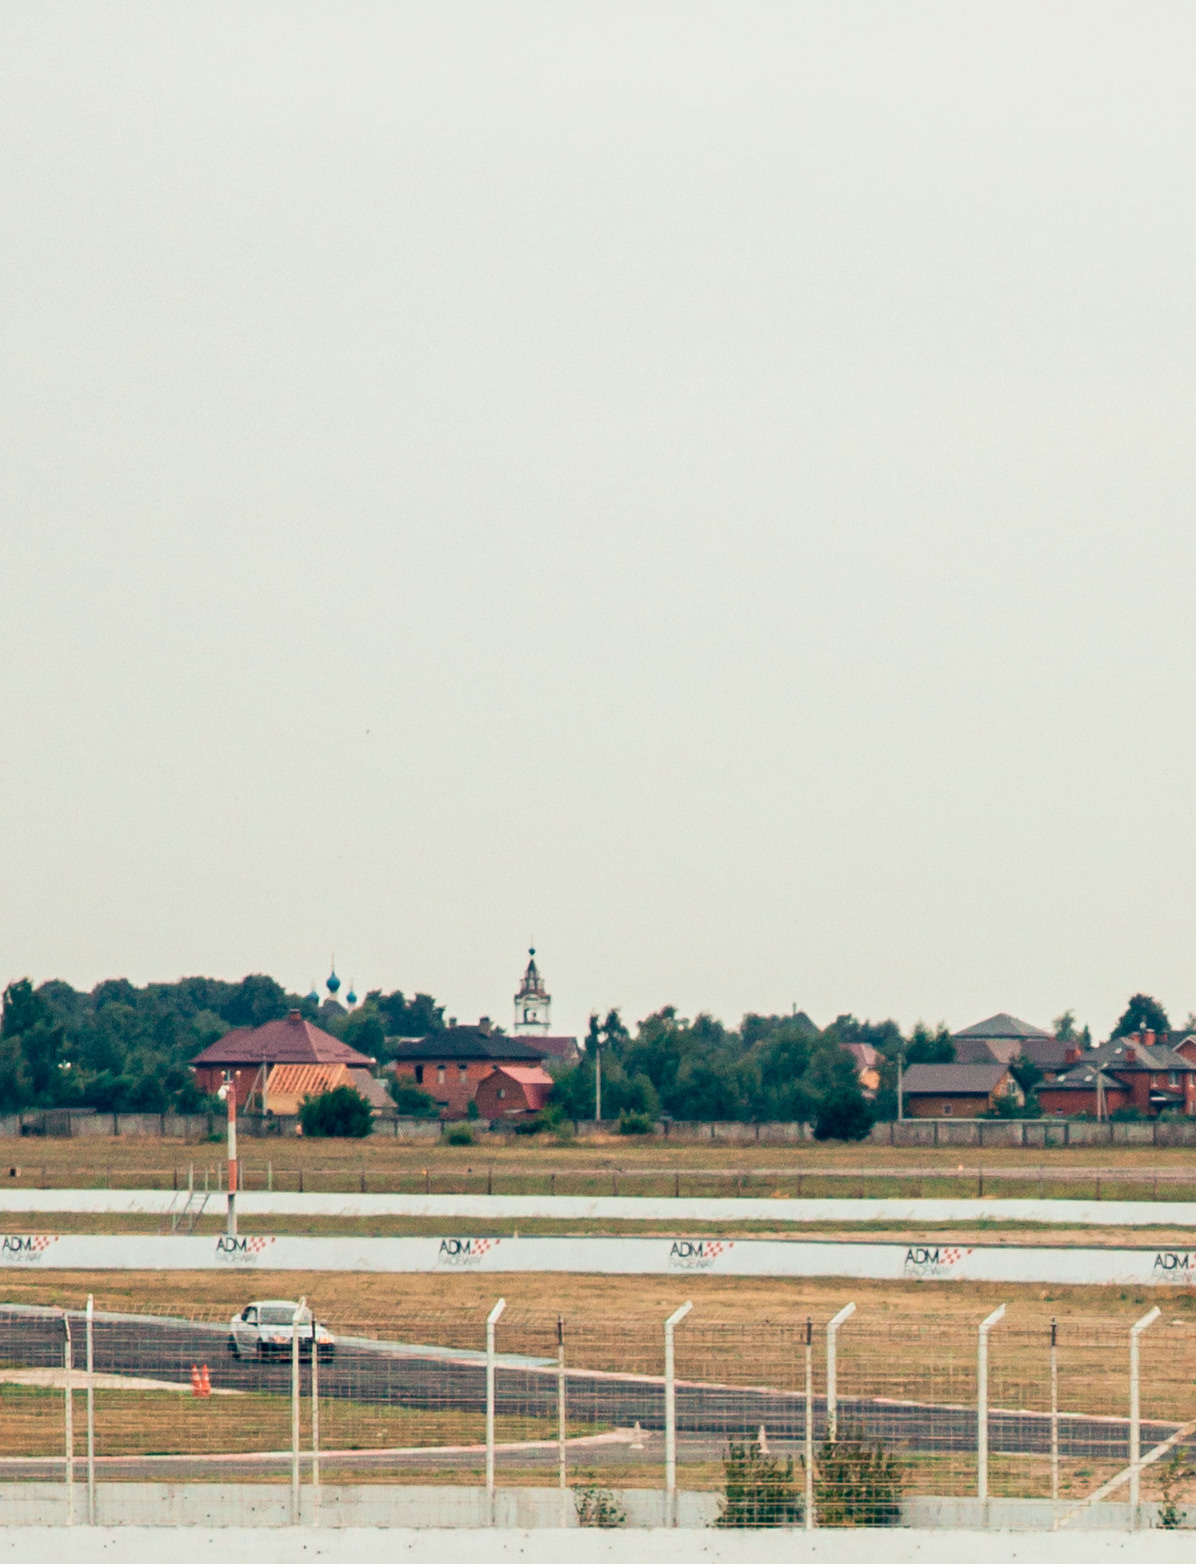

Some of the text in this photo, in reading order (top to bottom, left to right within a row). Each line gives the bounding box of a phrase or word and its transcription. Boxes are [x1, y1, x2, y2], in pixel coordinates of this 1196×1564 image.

[2, 1236, 32, 1252] ADM
[216, 1237, 247, 1253] ADM
[440, 1239, 471, 1255] ADM
[670, 1242, 703, 1258] ADM
[905, 1248, 939, 1264] ADM
[1153, 1253, 1189, 1270] ADM
